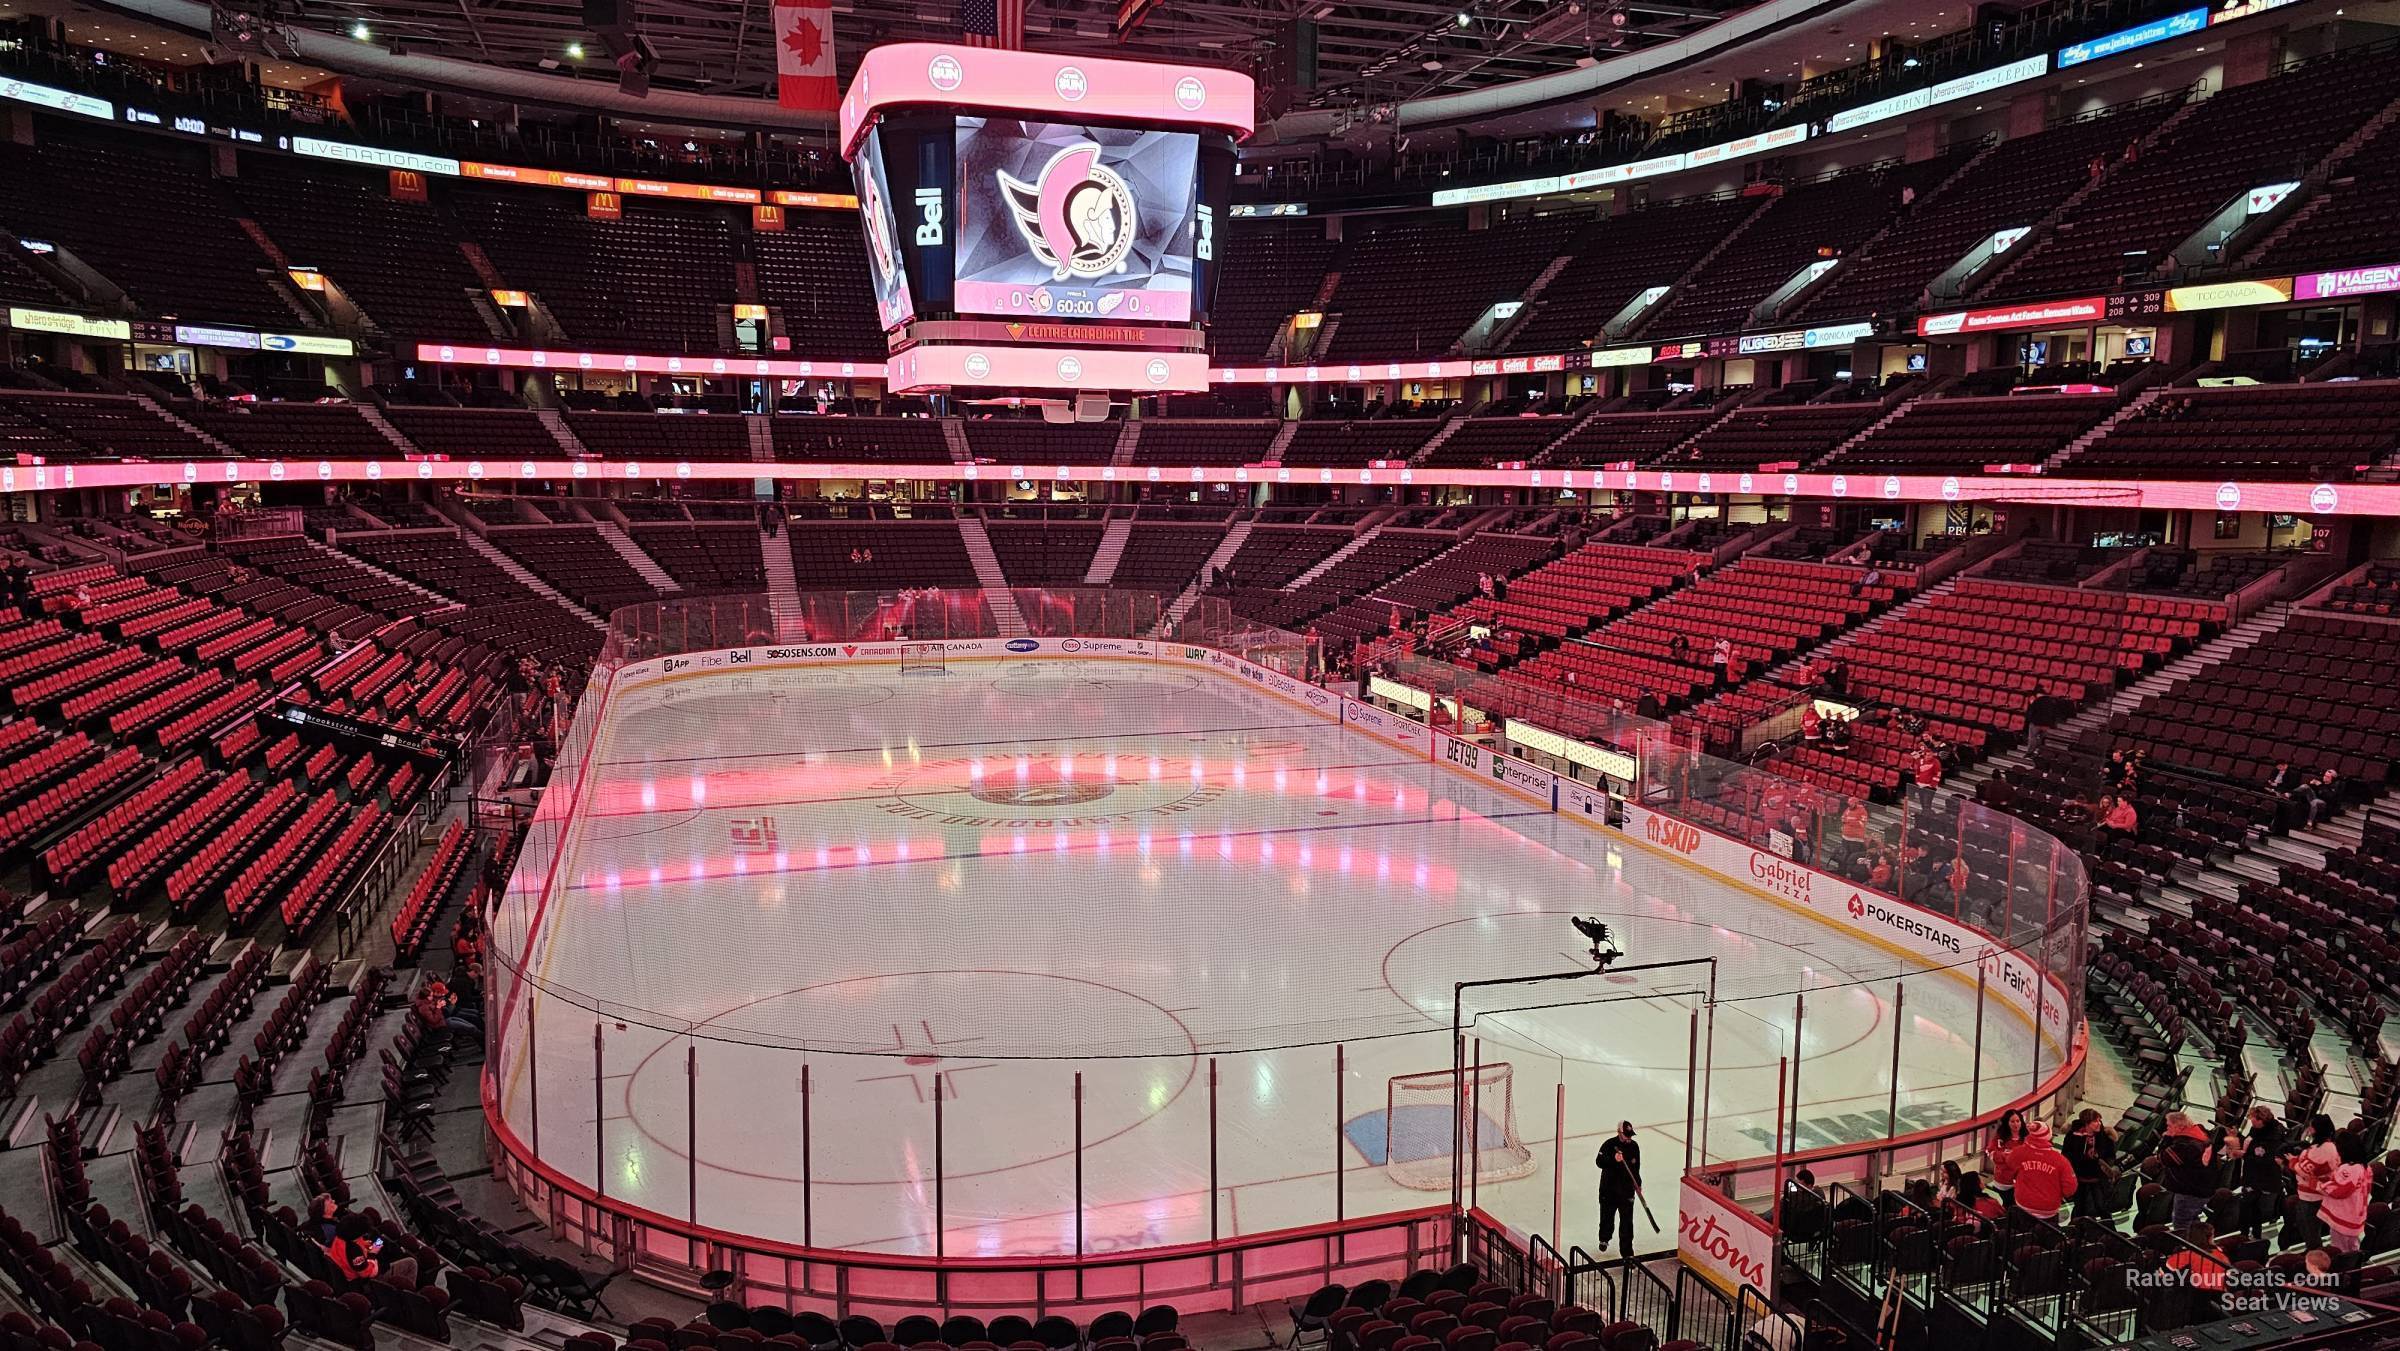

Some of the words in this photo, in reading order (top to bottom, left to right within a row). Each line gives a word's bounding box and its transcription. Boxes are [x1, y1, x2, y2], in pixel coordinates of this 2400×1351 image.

[915, 188, 943, 246] Bell
[1197, 203, 1212, 260] Bell
[1011, 292, 1022, 307] 0
[1056, 300, 1094, 313] 60:00
[1128, 297, 1139, 312] 0
[2109, 296, 2125, 305] 308
[2144, 293, 2160, 302] 309
[2109, 308, 2123, 316] 208
[2144, 305, 2159, 313] 209
[1028, 325, 1066, 338] CENTRE
[1067, 326, 1122, 340] CANADIAN
[1123, 329, 1145, 341] TIRE
[1660, 345, 1680, 356] ROSS
[194, 521, 209, 529] Rock
[2313, 529, 2330, 537] 107
[766, 647, 837, 659] 5050SENS.COM
[860, 648, 896, 656] CANADIAN
[946, 643, 983, 651] CANADA
[1083, 641, 1121, 652] Supreme
[1166, 647, 1206, 660] SUBWAY
[674, 659, 690, 669] APP
[702, 656, 722, 666] Fibe
[731, 650, 751, 663] Bell
[307, 714, 358, 733] brookstreet
[1359, 708, 1382, 726] Supreme
[1447, 738, 1478, 769] BET99
[1496, 761, 1547, 790] enterprise
[1661, 819, 1701, 855] SKIP
[1750, 851, 1812, 891] Gabriel
[1767, 879, 1811, 904] PIZZA
[1867, 904, 1960, 954] POKERSTARS
[2004, 961, 2060, 1026] FairSqare
[2021, 1160, 2056, 1175] DETROIT
